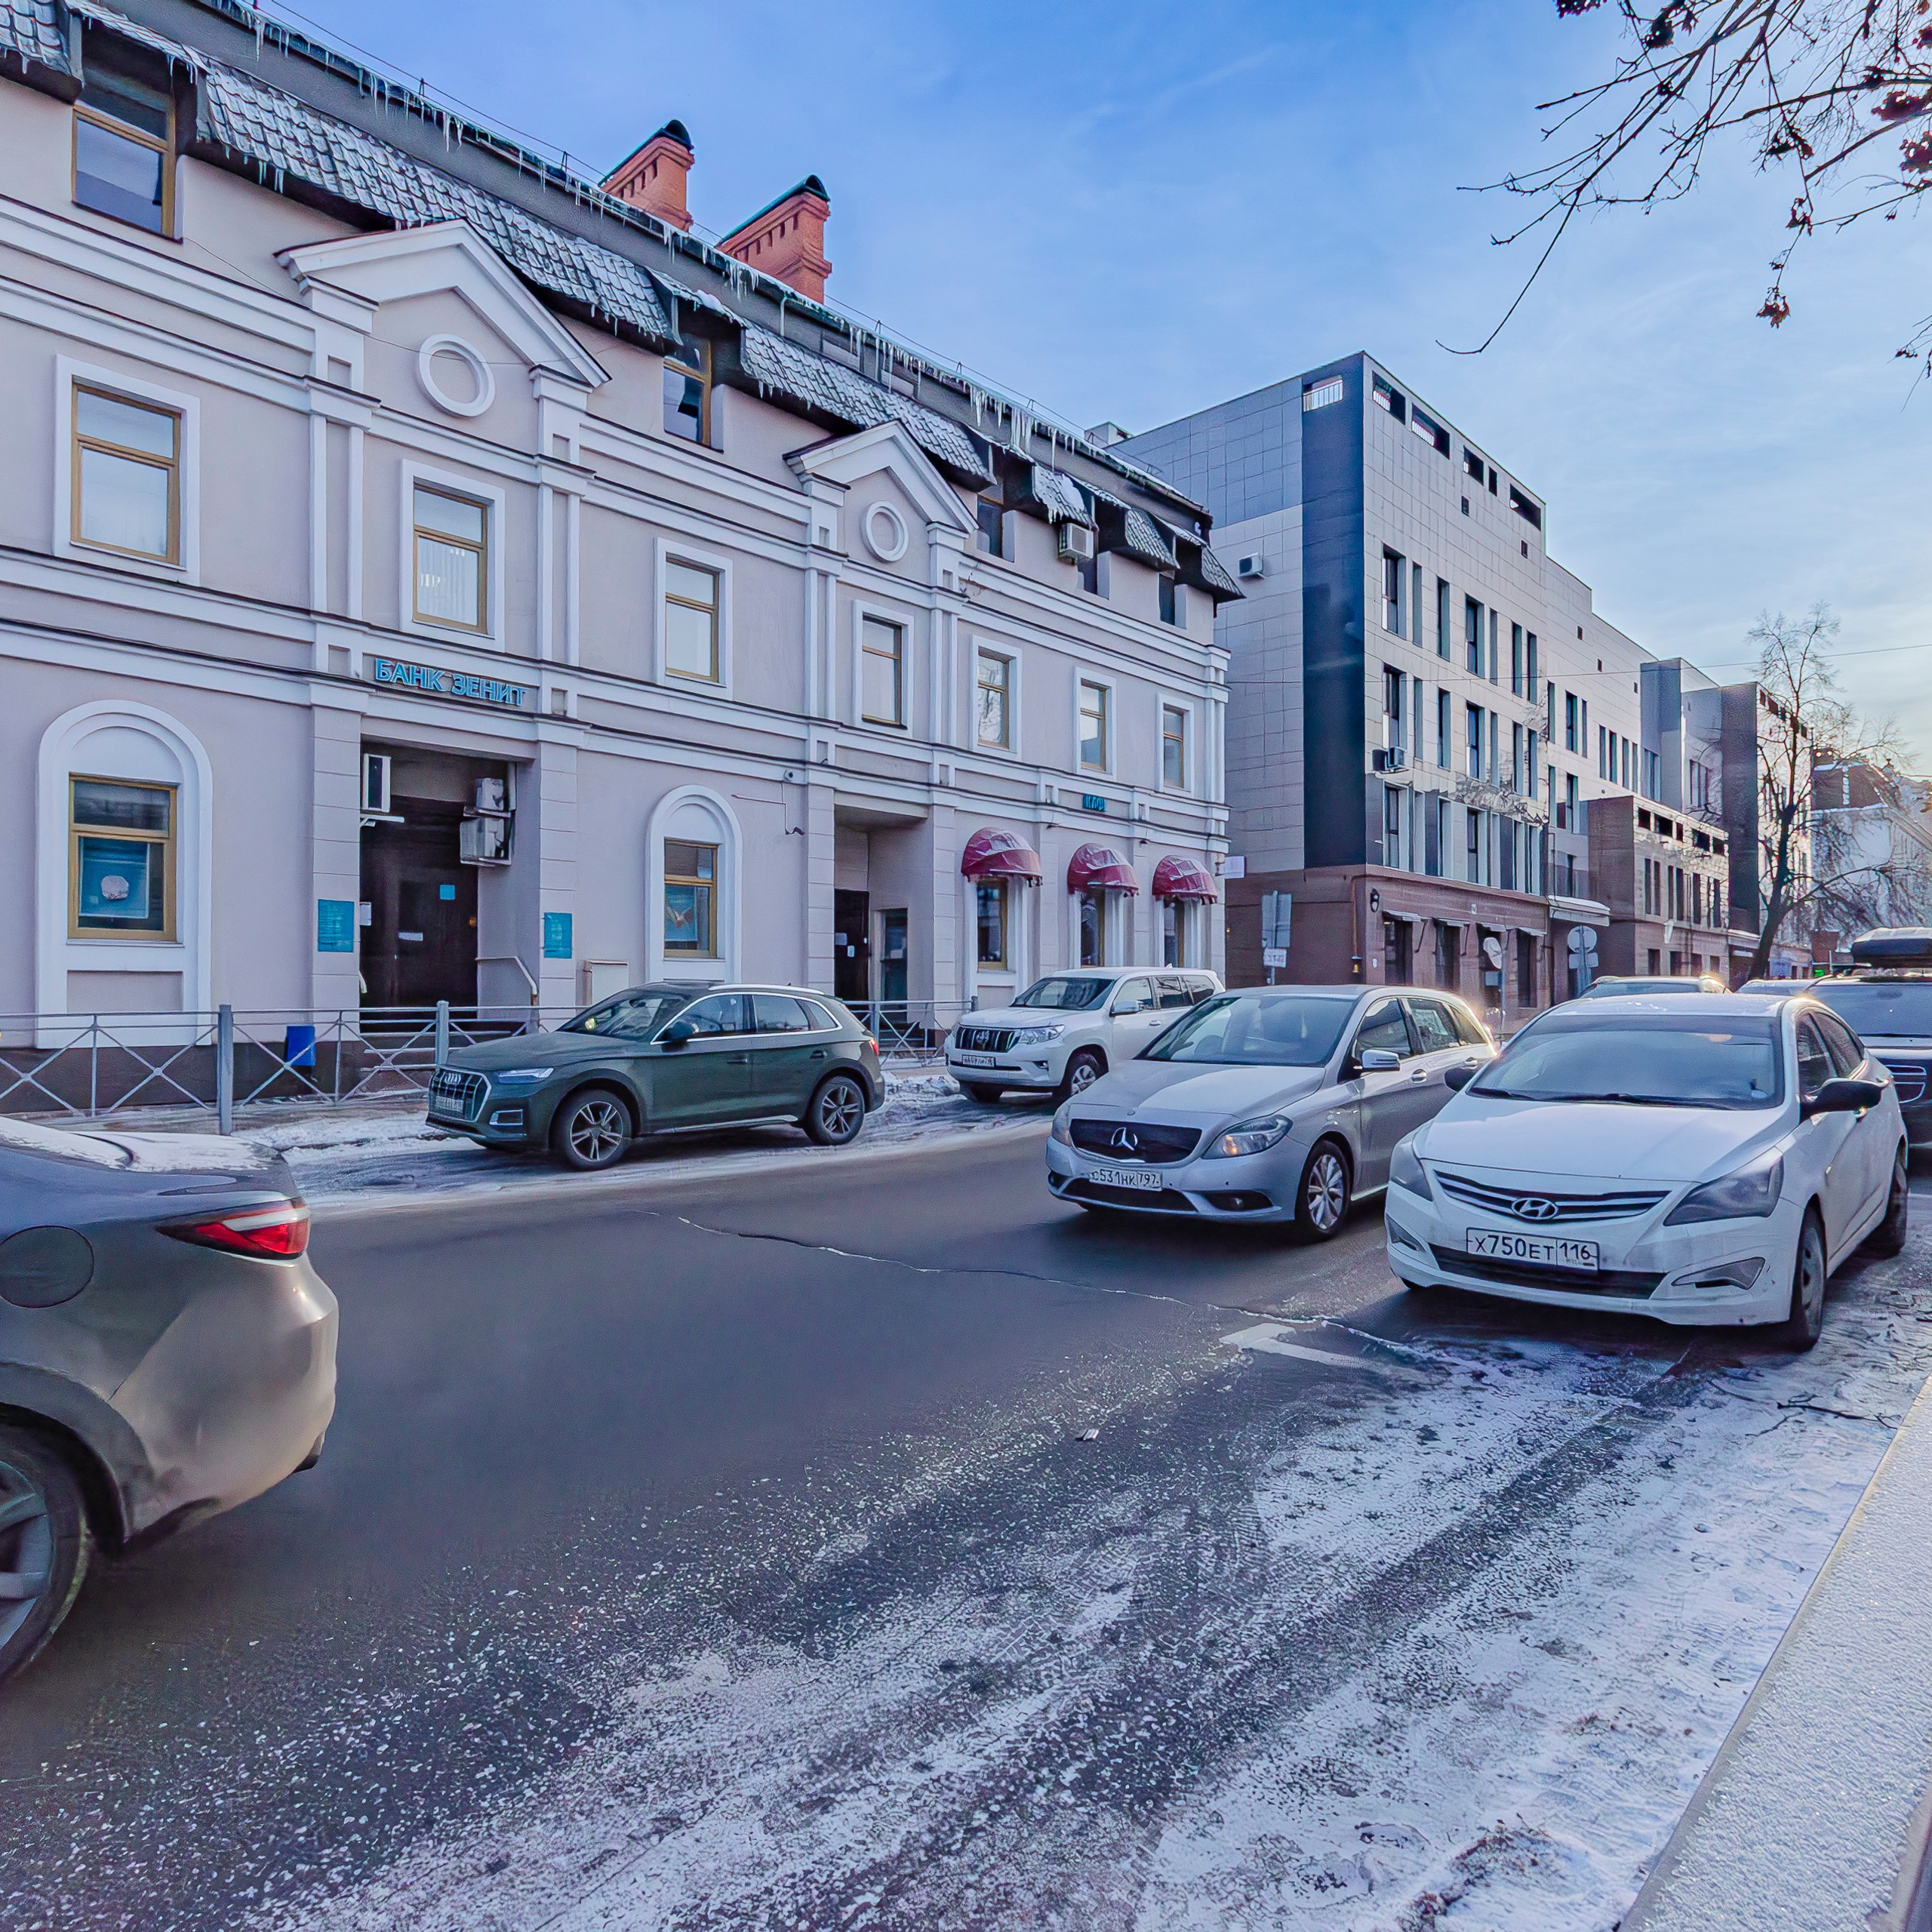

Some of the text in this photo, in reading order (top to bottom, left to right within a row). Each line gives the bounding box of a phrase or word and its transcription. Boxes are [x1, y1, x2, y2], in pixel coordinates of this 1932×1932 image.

[374, 657, 527, 706] БАНК ЗЕНИТ
[1559, 1241, 1591, 1260] 116
